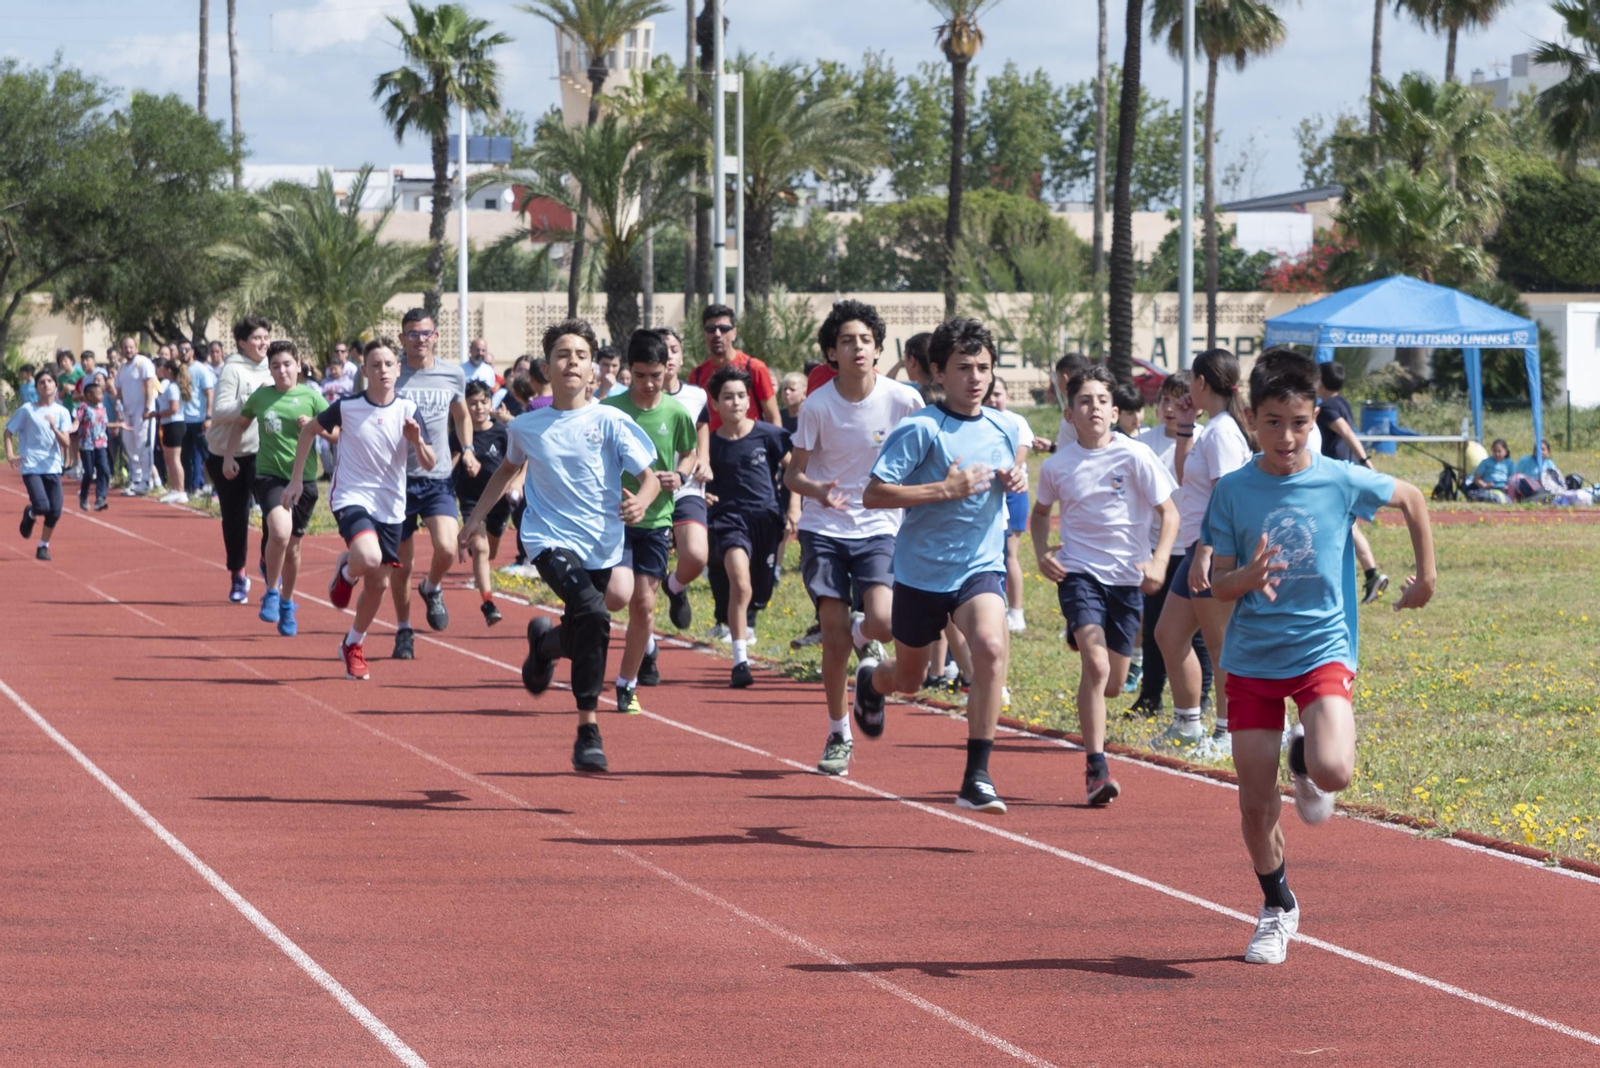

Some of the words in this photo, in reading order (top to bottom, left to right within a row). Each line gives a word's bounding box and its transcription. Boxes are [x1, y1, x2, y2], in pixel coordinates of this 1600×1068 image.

[1347, 332, 1378, 344] CLUB
[1378, 333, 1396, 345] DE
[1396, 333, 1461, 345] ATLETISMO
[1462, 332, 1510, 345] LINENSE
